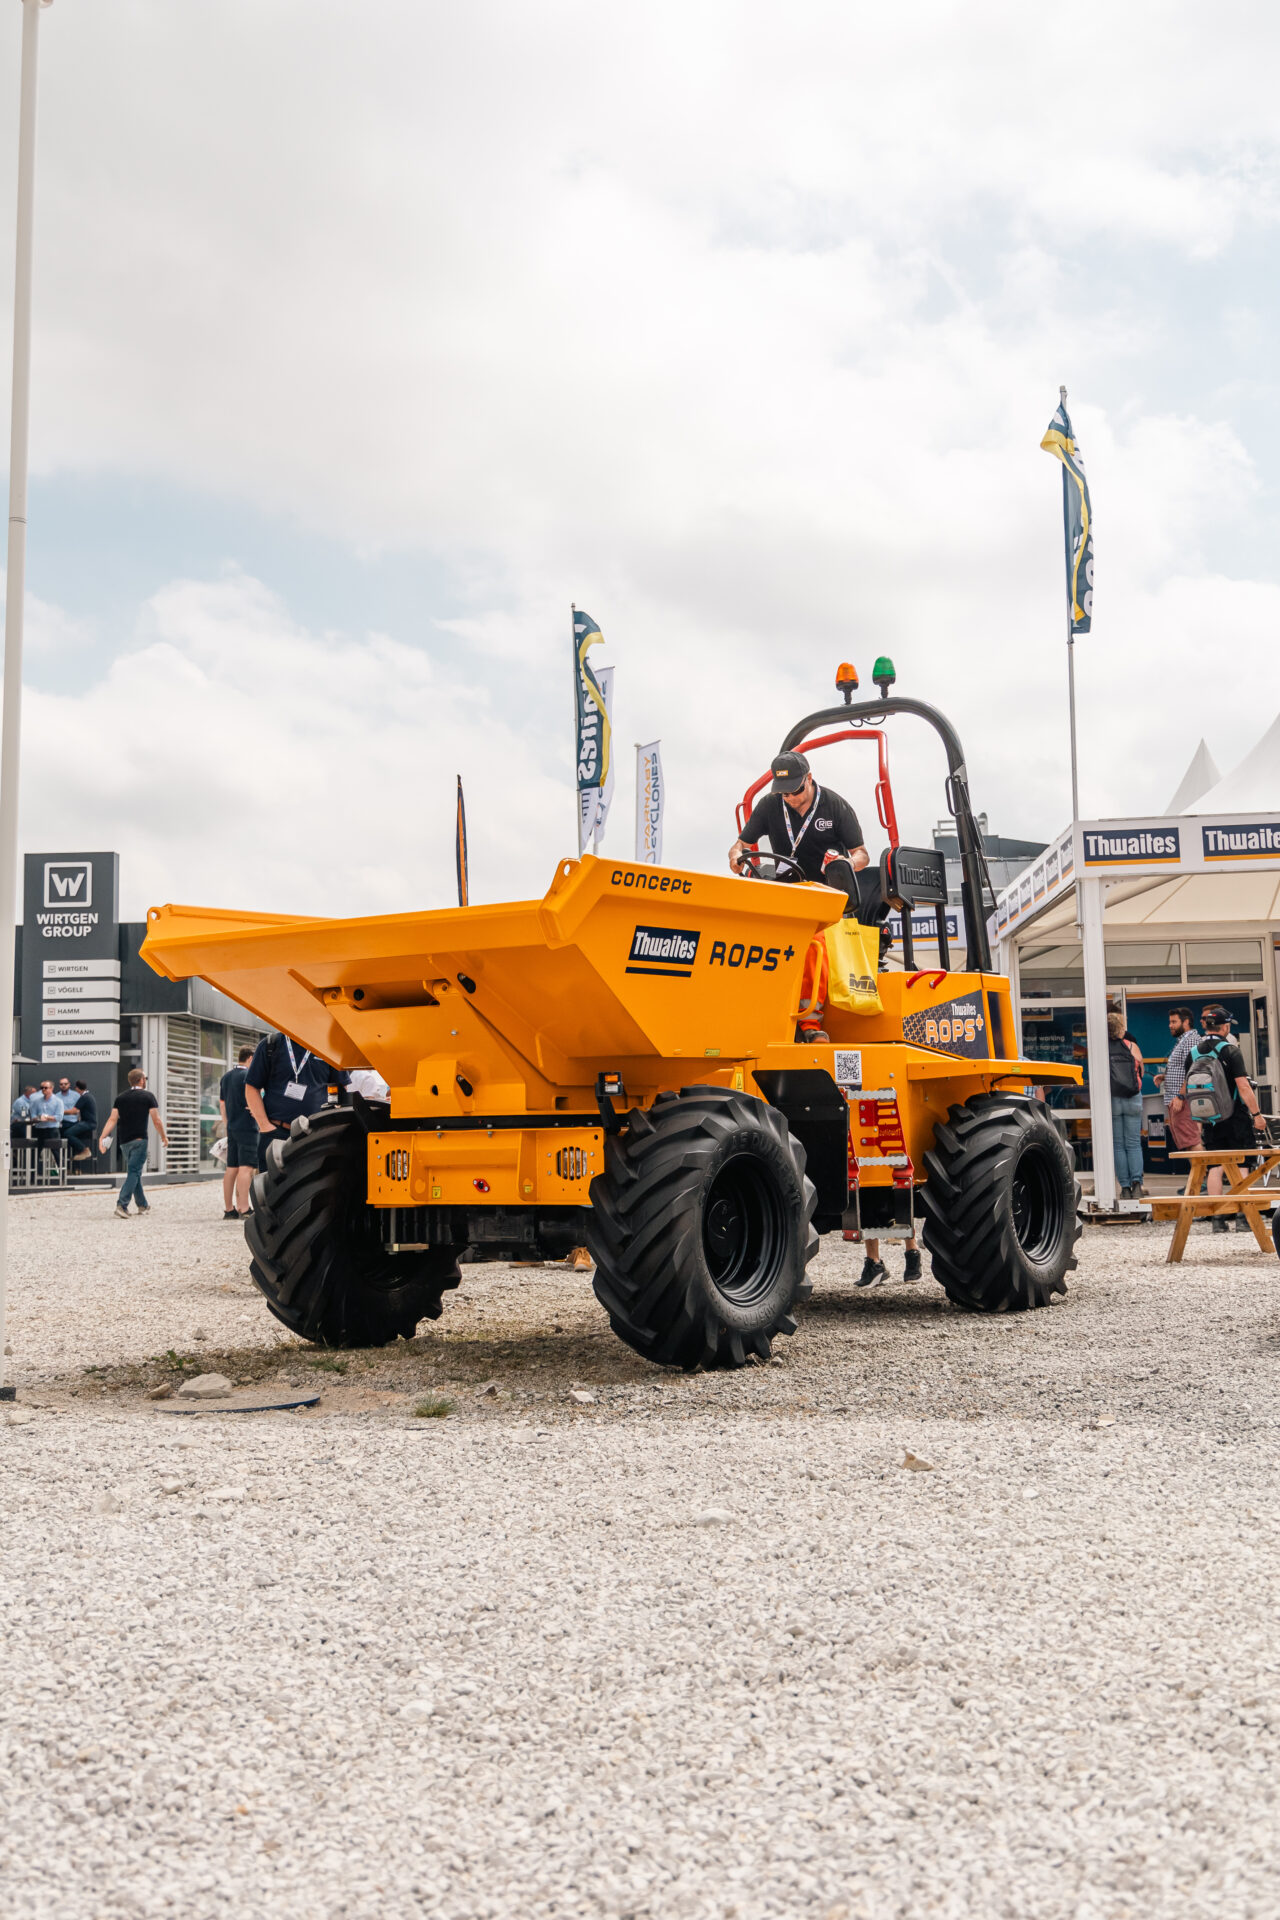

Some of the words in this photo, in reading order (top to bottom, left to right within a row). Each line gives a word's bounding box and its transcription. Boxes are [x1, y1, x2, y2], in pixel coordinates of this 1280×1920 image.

[650, 752, 660, 849] CYCLONES
[1086, 833, 1176, 857] Thwaites
[611, 870, 692, 894] concept
[898, 862, 944, 888] Thwaites
[36, 912, 99, 925] WIRTGEN
[890, 918, 956, 937] Twaits
[42, 925, 92, 938] GROUP
[633, 931, 697, 960] Thwaites
[709, 940, 795, 972] ROPS+
[57, 965, 89, 973] WIRTGEN
[57, 986, 84, 994] VÖGELE
[951, 1002, 977, 1016] Thwaites
[925, 1013, 985, 1044] ROPS+
